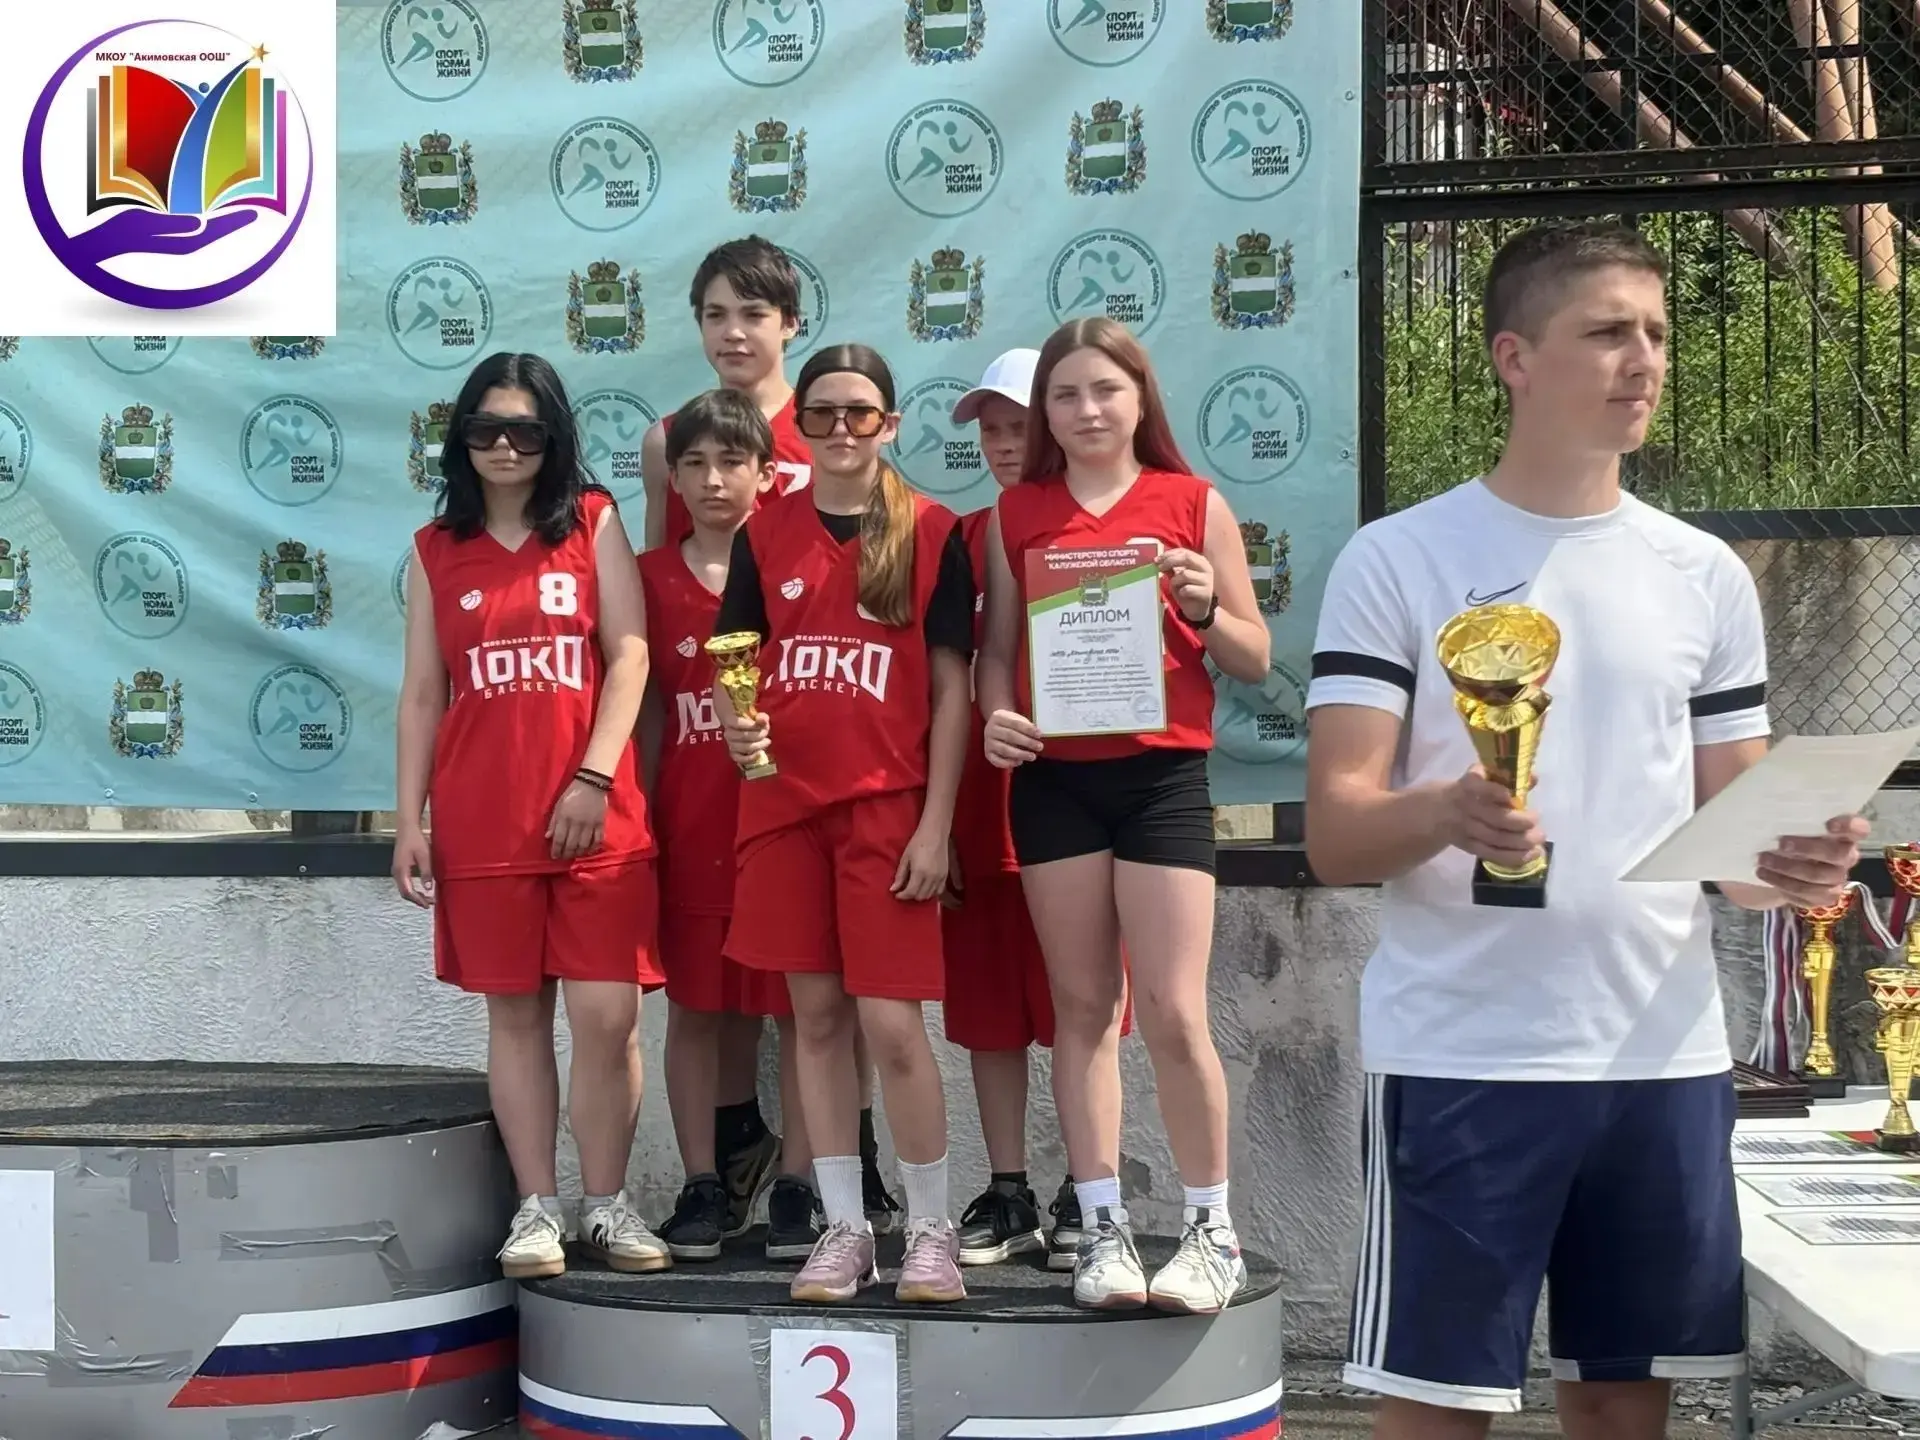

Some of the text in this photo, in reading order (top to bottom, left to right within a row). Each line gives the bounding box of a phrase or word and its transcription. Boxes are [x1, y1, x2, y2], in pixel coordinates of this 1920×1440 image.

[1106, 21, 1144, 32] НОРМА
[1107, 31, 1144, 42] ЖИЗНИ
[768, 43, 803, 53] НОРМА
[768, 53, 803, 63] ЖИЗНИ
[436, 59, 471, 68] НОРМА
[437, 68, 471, 78] ЖИЗНИ
[1251, 155, 1289, 167] НОРМА
[1252, 165, 1289, 177] ЖИЗНИ
[945, 173, 982, 184] НОРМА
[946, 183, 982, 194] ЖИЗНИ
[605, 190, 640, 199] НОРМА
[605, 199, 639, 208] ЖИЗНИ
[1106, 303, 1144, 314] НОРМА
[440, 327, 474, 338] НОРМА
[134, 342, 166, 351] ЖИЗНИ
[441, 337, 475, 347] ЖИЗНИ
[1252, 440, 1288, 450] НОРМА
[945, 451, 981, 460] НОРМА
[1252, 449, 1288, 460] ЖИЗНИ
[291, 465, 324, 474] НОРМА
[612, 461, 641, 470] НОРМ
[946, 460, 981, 470] ЖИЗНИ
[292, 473, 324, 483] ЖИЗНИ
[1044, 548, 1140, 561] МИНИСТЕРСТВО СПОРТА
[1048, 557, 1136, 570] КАЛУЖСКОЙ ОБЛАСТИ
[538, 572, 578, 616] 8
[143, 600, 174, 609] НОРМА
[145, 609, 176, 618] ЖИЗНИ
[1059, 608, 1130, 627] ДИПЛОМ
[484, 681, 559, 700] БАСКЕТ
[784, 678, 859, 698] БАСКЕТ
[0, 727, 29, 736] ОРМА
[1257, 723, 1294, 732] НОРМА
[300, 732, 333, 741] НОРМА
[689, 730, 723, 744] БАС
[1258, 731, 1295, 742] ЖИЗНИ
[300, 741, 333, 751] ЖИЗНИ
[801, 1345, 855, 1440] 3
